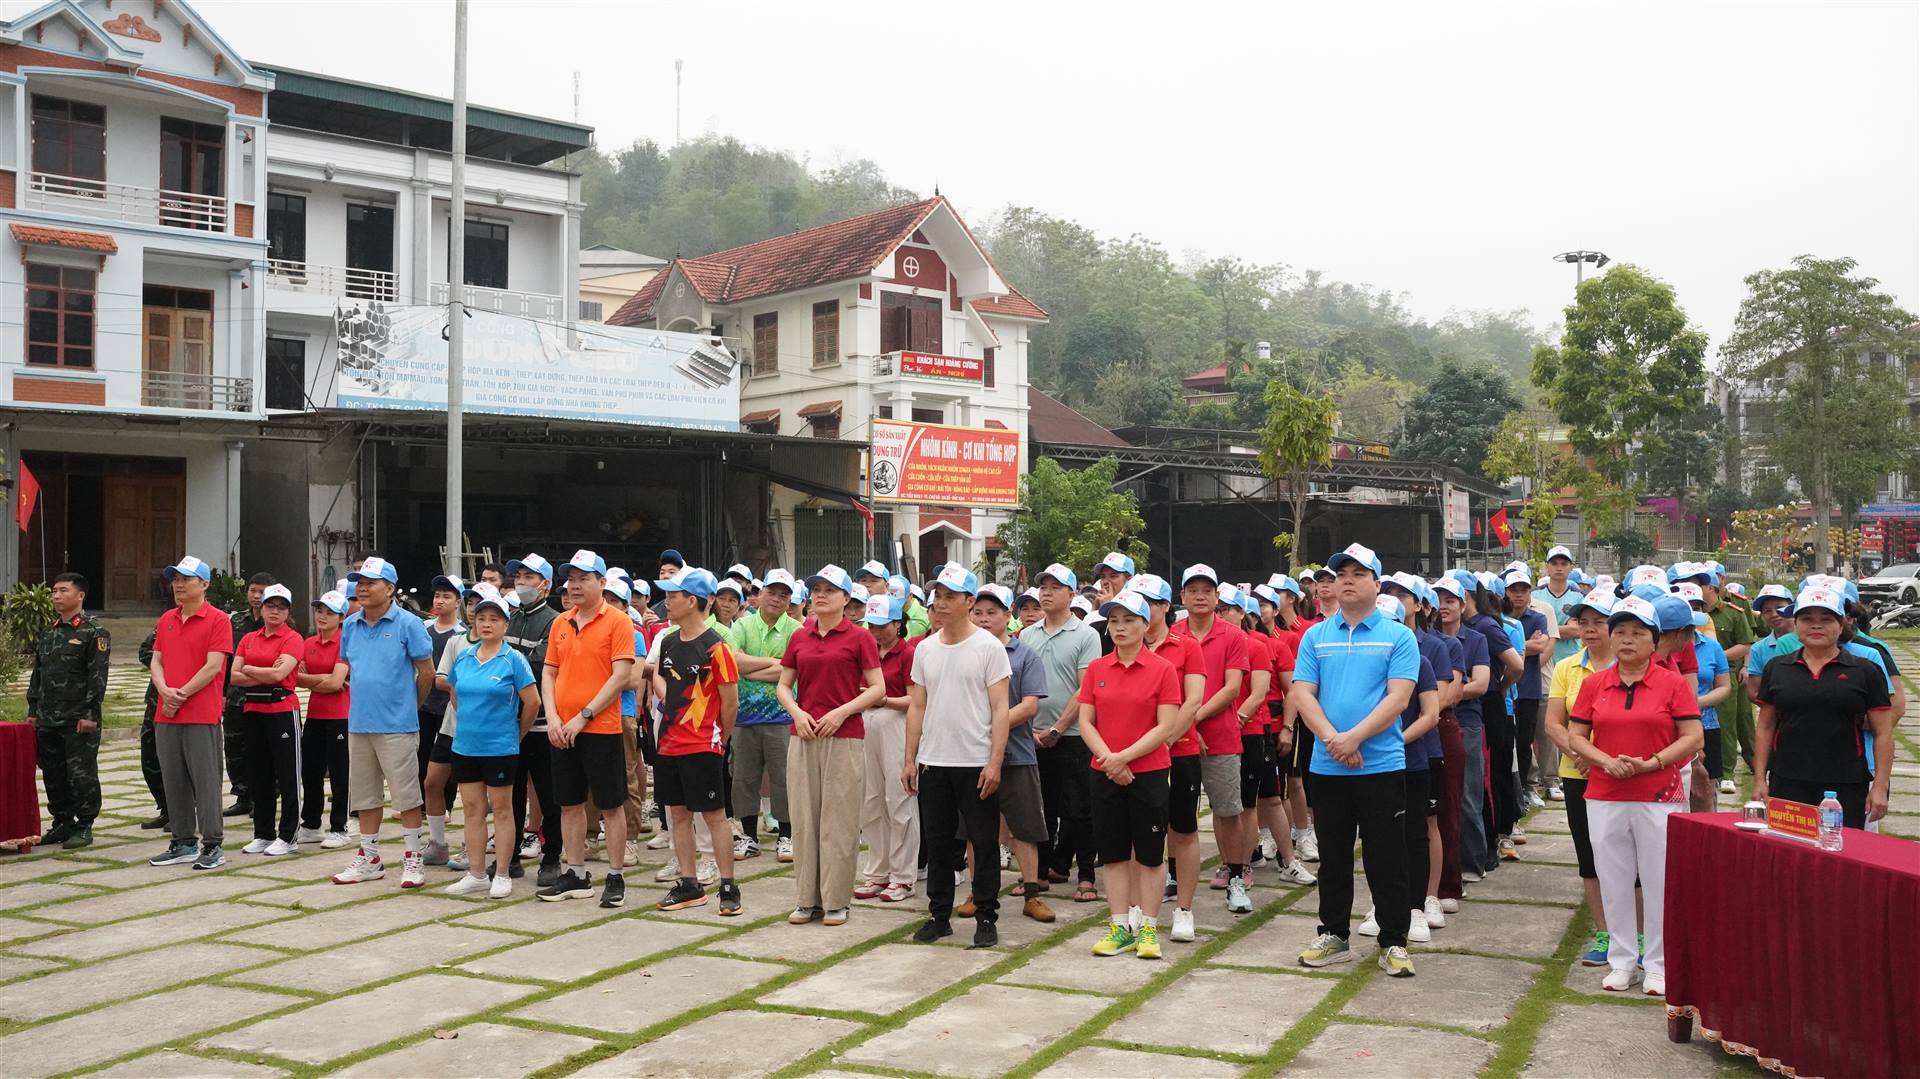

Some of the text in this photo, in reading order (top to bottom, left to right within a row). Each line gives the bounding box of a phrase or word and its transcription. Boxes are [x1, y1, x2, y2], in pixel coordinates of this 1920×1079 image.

[963, 441, 973, 460] CƠ
[974, 441, 985, 462] KHÍ
[986, 438, 1002, 462] TỔNG
[1004, 445, 1016, 467] HỢP
